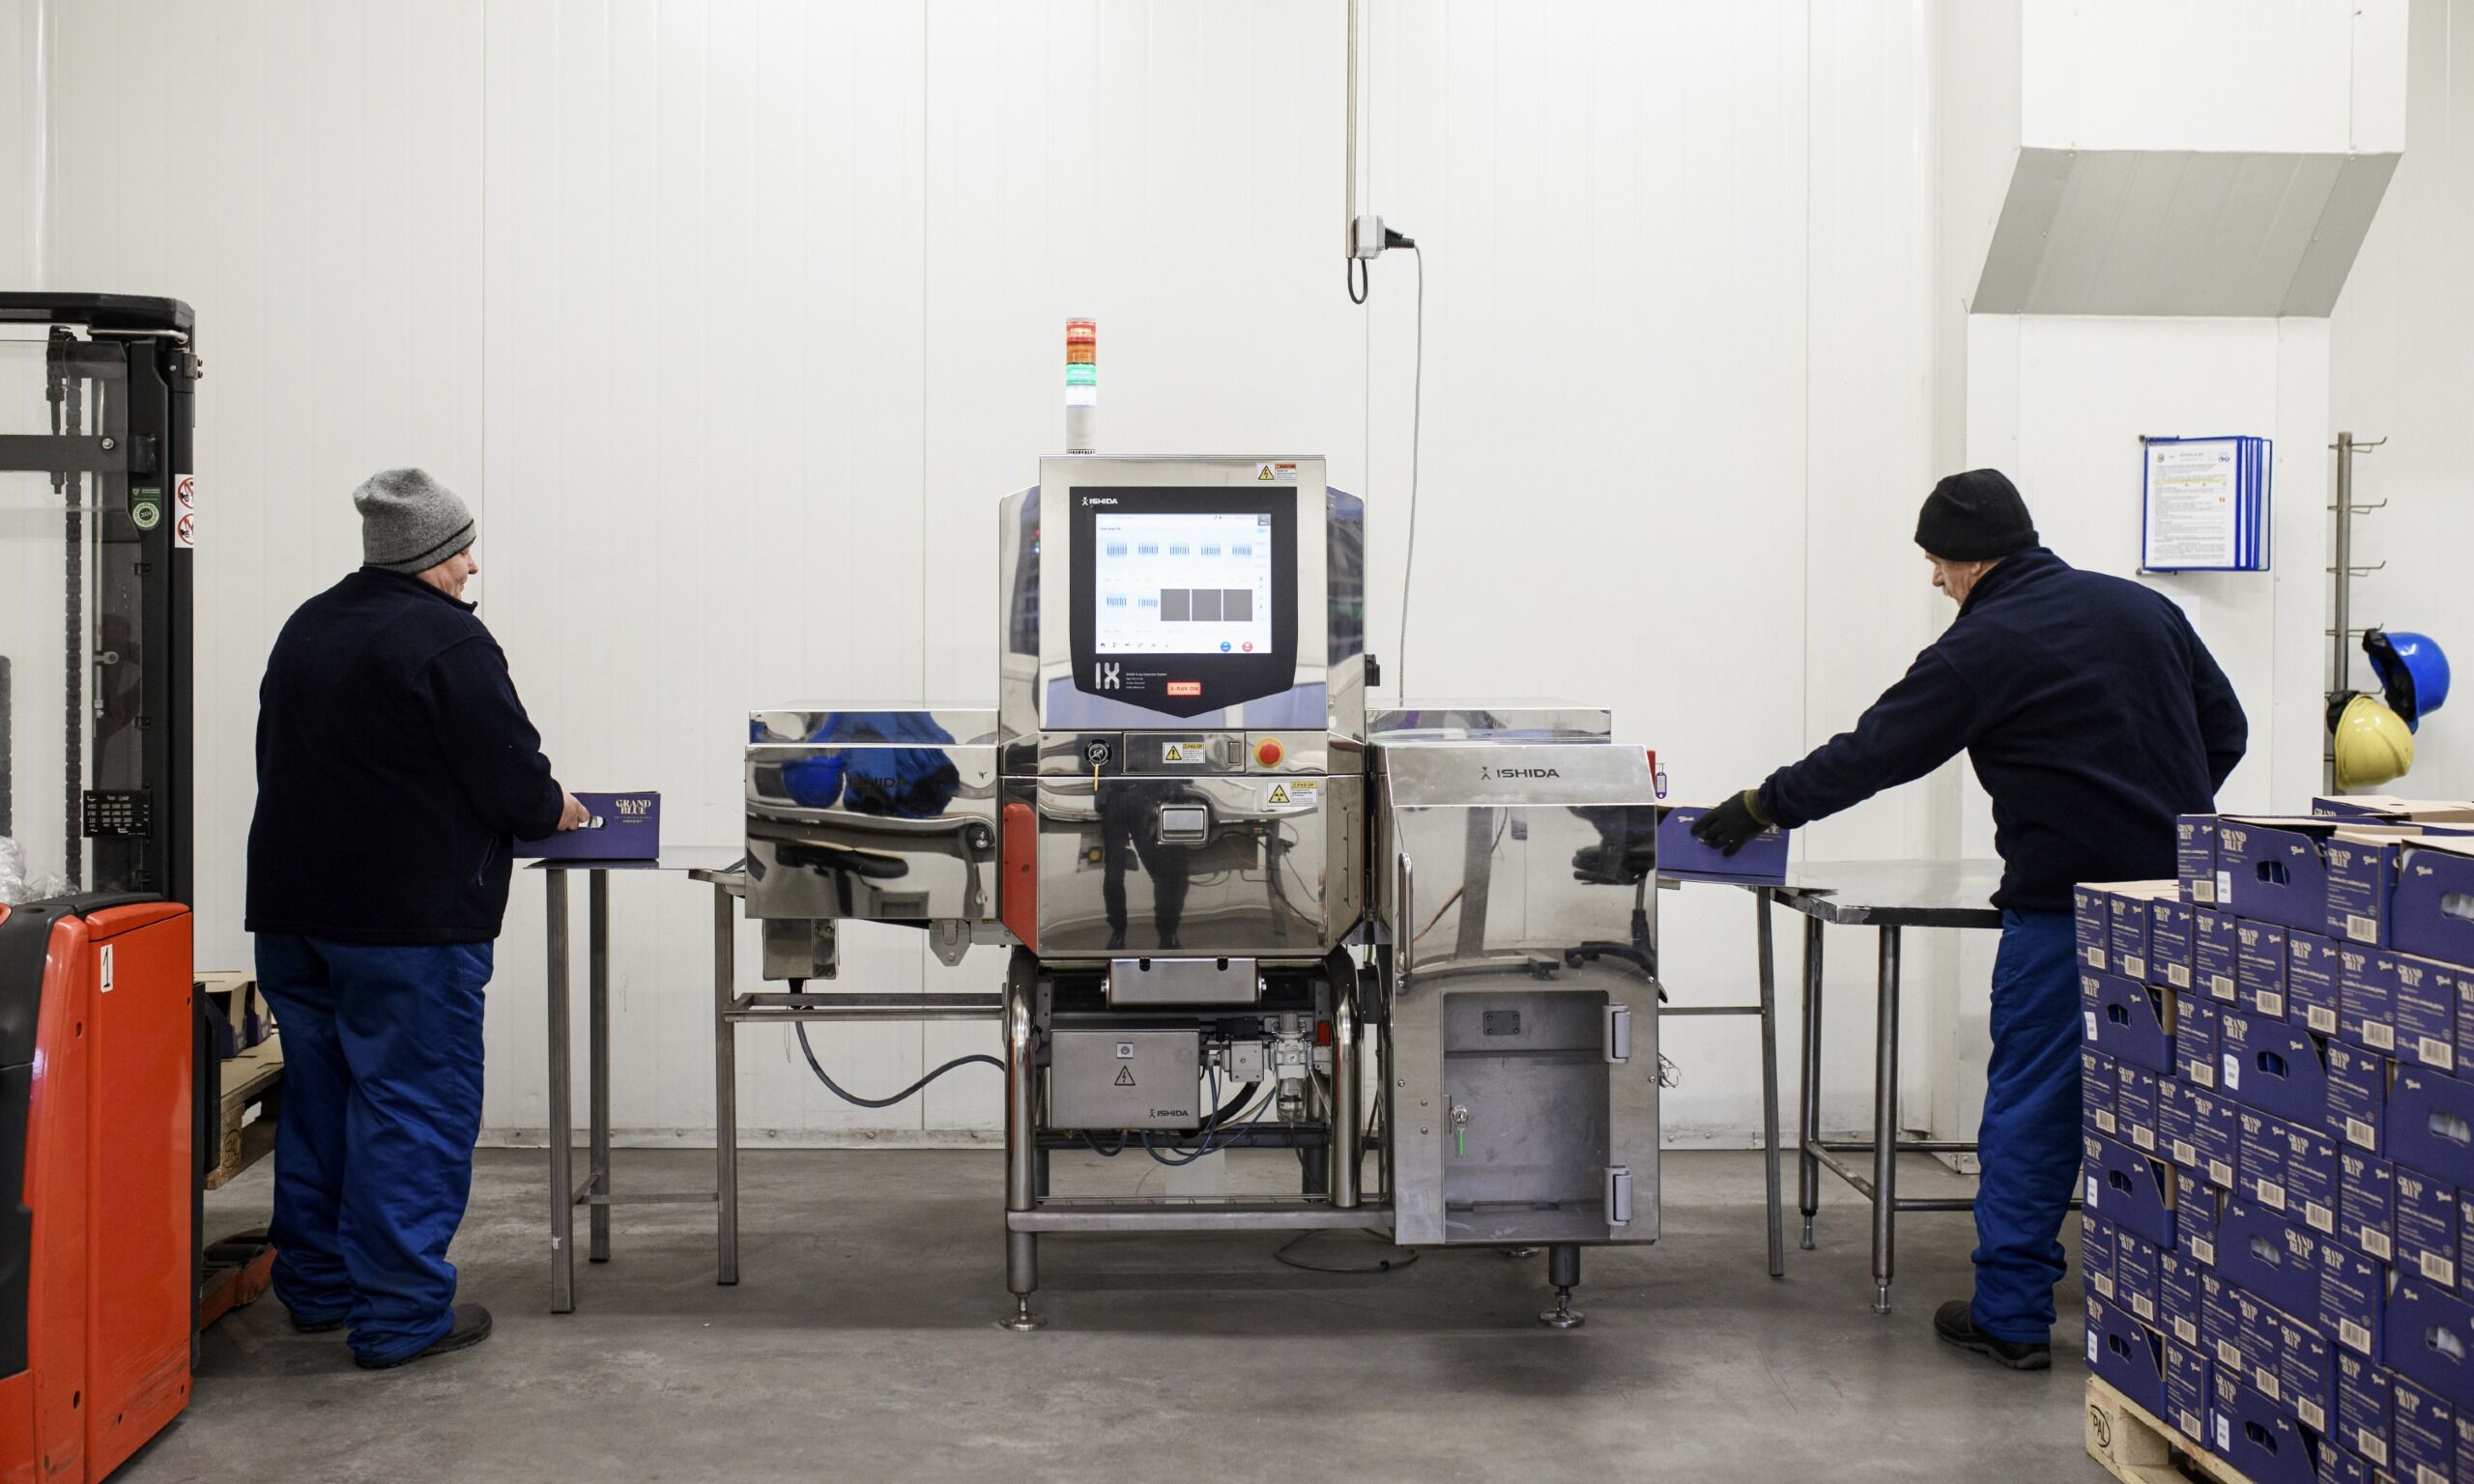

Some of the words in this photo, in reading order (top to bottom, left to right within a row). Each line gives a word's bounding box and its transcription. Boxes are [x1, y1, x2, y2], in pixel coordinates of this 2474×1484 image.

[1095, 662, 1120, 689] IX
[1497, 769, 1560, 778] ISHIDA
[2221, 828, 2246, 842] GRAND
[2225, 840, 2243, 851] BLUE
[2328, 848, 2351, 859] GRAND
[2332, 857, 2348, 867] BLUE
[2074, 893, 2087, 902] GRAND
[2111, 899, 2125, 909] GRAND
[2154, 905, 2170, 915] GRAND
[2197, 915, 2214, 925] GRAND
[2238, 928, 2258, 938] GRAND
[2241, 937, 2256, 946] BLUE
[2290, 939, 2311, 951] GRAND
[2293, 949, 2308, 958] BLUE
[2341, 951, 2365, 964] GRAND
[2345, 962, 2362, 972] BLUE
[2397, 965, 2423, 978] GRAND
[2081, 975, 2099, 988] GRAND
[2401, 975, 2420, 986] BLUE
[2177, 1000, 2194, 1012] GRAND
[2223, 1015, 2247, 1031] GRAND
[2227, 1027, 2244, 1041] BLUE
[2082, 1053, 2096, 1064] GRAND
[2328, 1048, 2349, 1062] GRAND
[2331, 1059, 2347, 1069] BLUE
[2118, 1066, 2134, 1077] GRAND
[2159, 1080, 2175, 1091] GRAND
[2195, 1097, 2212, 1110] GRAND
[2240, 1113, 2261, 1127] GRAND
[2244, 1124, 2258, 1134] BLUE
[2084, 1136, 2101, 1151] GRAND
[2288, 1133, 2309, 1148] GRAND
[2291, 1145, 2305, 1155] BLUE
[2342, 1155, 2363, 1169] GRAND
[2345, 1166, 2361, 1176] BLUE
[2178, 1174, 2194, 1187] GRAND
[2397, 1176, 2422, 1192] GRAND
[2402, 1188, 2419, 1199] BLUE
[2082, 1214, 2096, 1227] GRAND
[2119, 1232, 2135, 1246] GRAND
[2285, 1228, 2313, 1250] GRAND
[2289, 1241, 2309, 1257] BLUE
[2322, 1245, 2344, 1262] GRAND
[2161, 1253, 2177, 1267] GRAND
[2325, 1257, 2341, 1270] BLUE
[2202, 1274, 2220, 1289] GRAND
[2087, 1296, 2102, 1313] GRAND
[2239, 1299, 2258, 1314] GRAND
[2281, 1325, 2301, 1341] GRAND
[2284, 1337, 2298, 1349] BLUE
[2167, 1346, 2183, 1360] GRAND
[2339, 1354, 2360, 1371] GRAND
[2342, 1365, 2357, 1379] BLUE
[2215, 1373, 2236, 1396] GRAND
[2218, 1388, 2234, 1402] BLUE
[2395, 1386, 2419, 1405] GRAND
[2398, 1398, 2416, 1412] BLUE
[2318, 1441, 2337, 1461] GRAND
